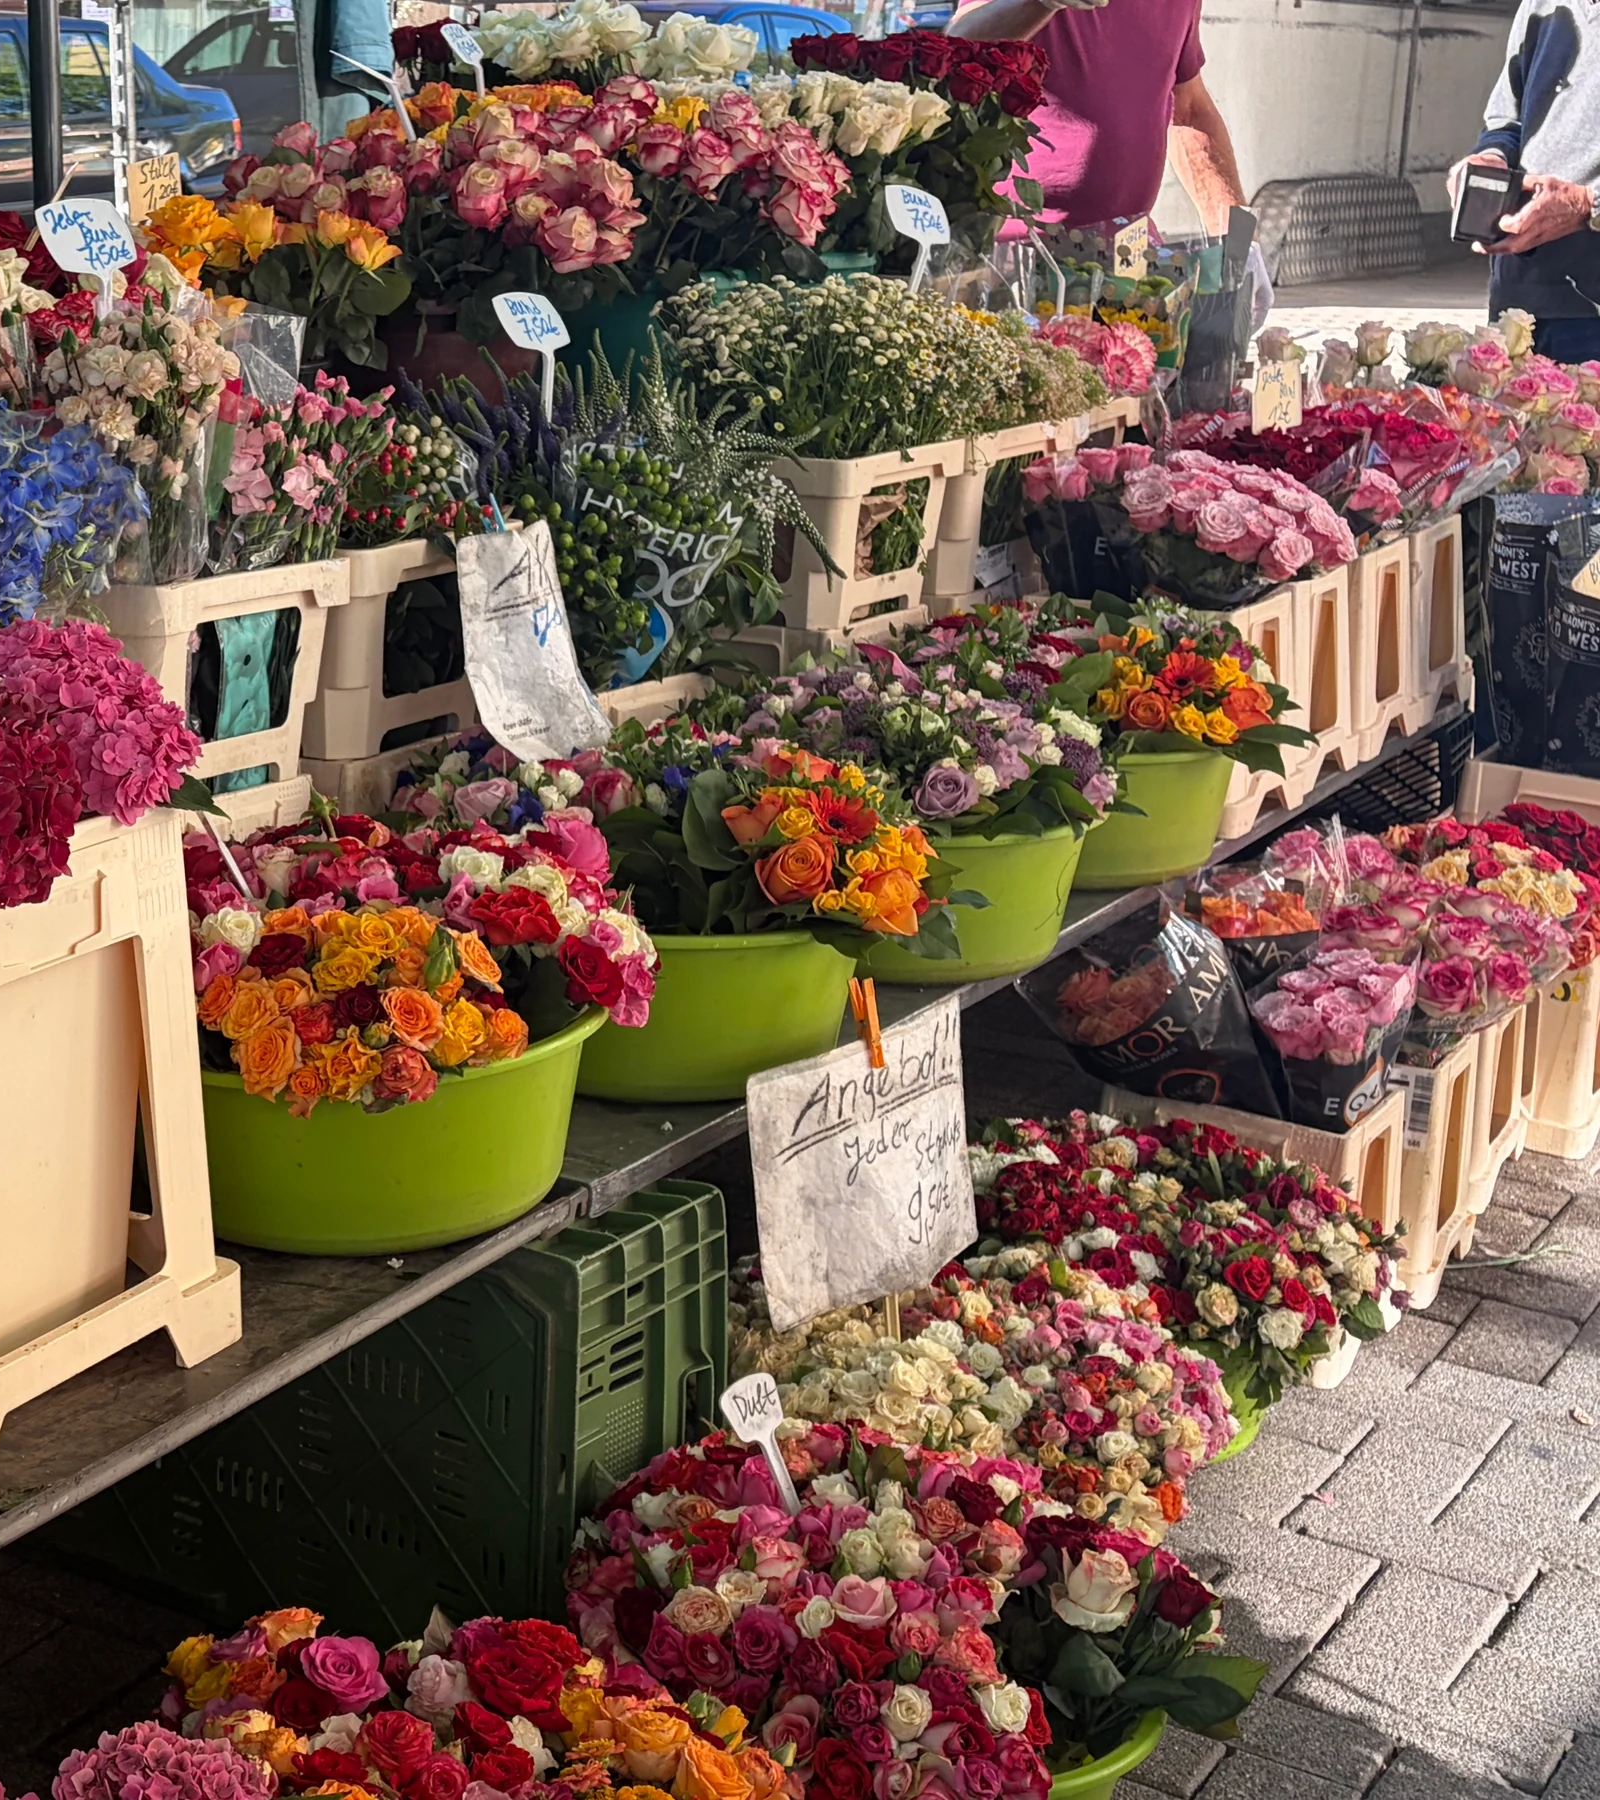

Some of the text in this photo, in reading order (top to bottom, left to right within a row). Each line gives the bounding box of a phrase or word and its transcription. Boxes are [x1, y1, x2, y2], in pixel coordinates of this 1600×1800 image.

[139, 156, 177, 184] Stück
[43, 204, 93, 234] Jeder
[78, 221, 122, 246] Bund
[76, 240, 133, 270] 7,50€
[516, 314, 560, 344] 7,50€
[1499, 557, 1540, 580] WEST
[843, 1116, 912, 1187] Jeder
[732, 1380, 777, 1424] Duft
